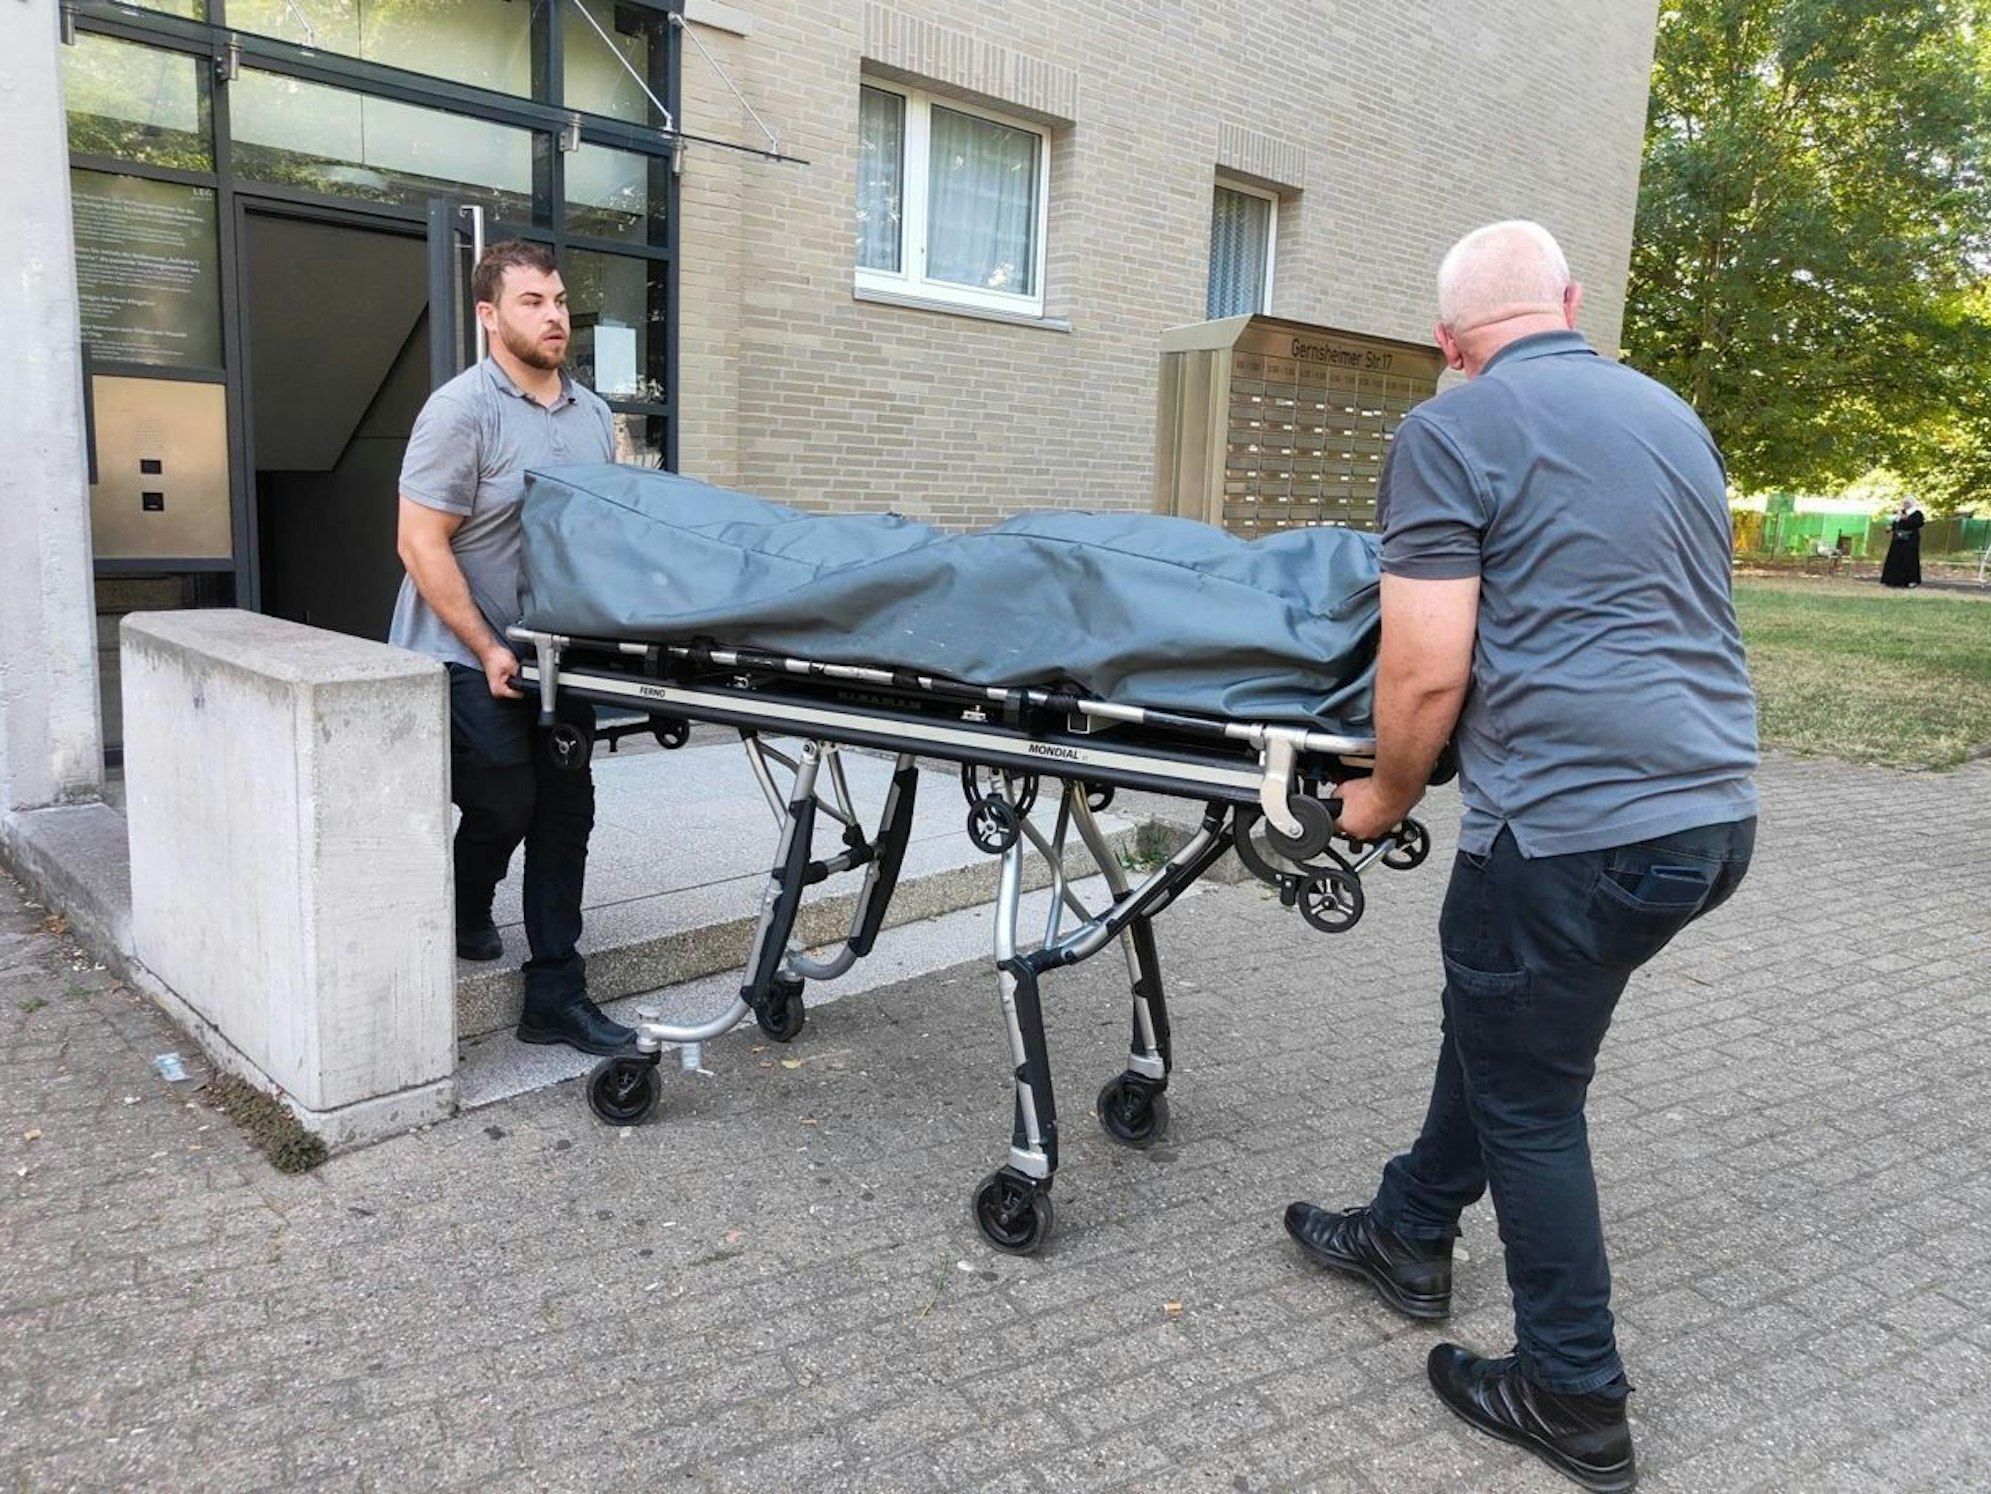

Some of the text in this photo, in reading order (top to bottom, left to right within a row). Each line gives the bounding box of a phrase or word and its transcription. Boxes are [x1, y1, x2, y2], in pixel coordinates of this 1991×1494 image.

[1291, 338, 1363, 367] Gernsheimer
[640, 685, 666, 698] FERNO
[1028, 744, 1079, 760] MONDIAL
